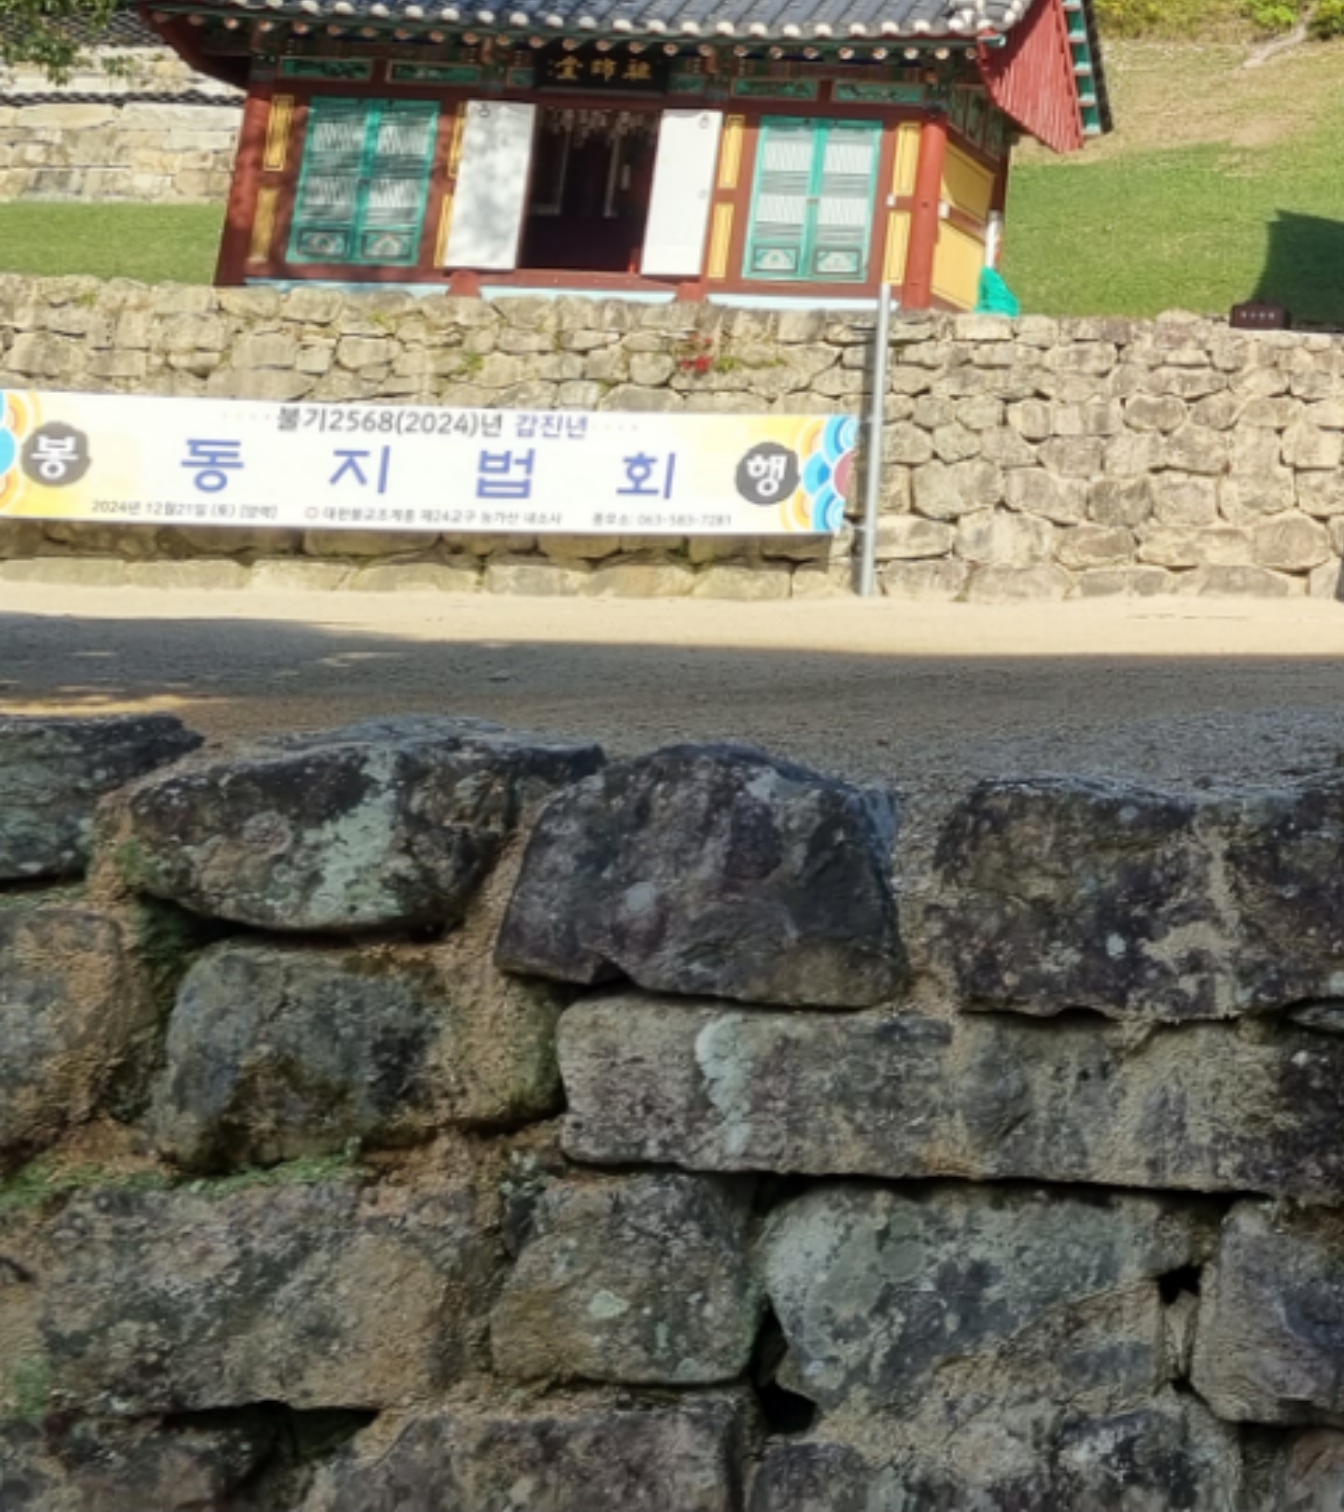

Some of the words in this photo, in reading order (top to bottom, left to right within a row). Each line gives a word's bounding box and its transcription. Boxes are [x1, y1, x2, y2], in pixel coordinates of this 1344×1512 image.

[277, 405, 503, 438] 불기2568(2024)년
[515, 413, 588, 439] 갑진년
[30, 435, 79, 480] 봉
[747, 454, 788, 497] 행
